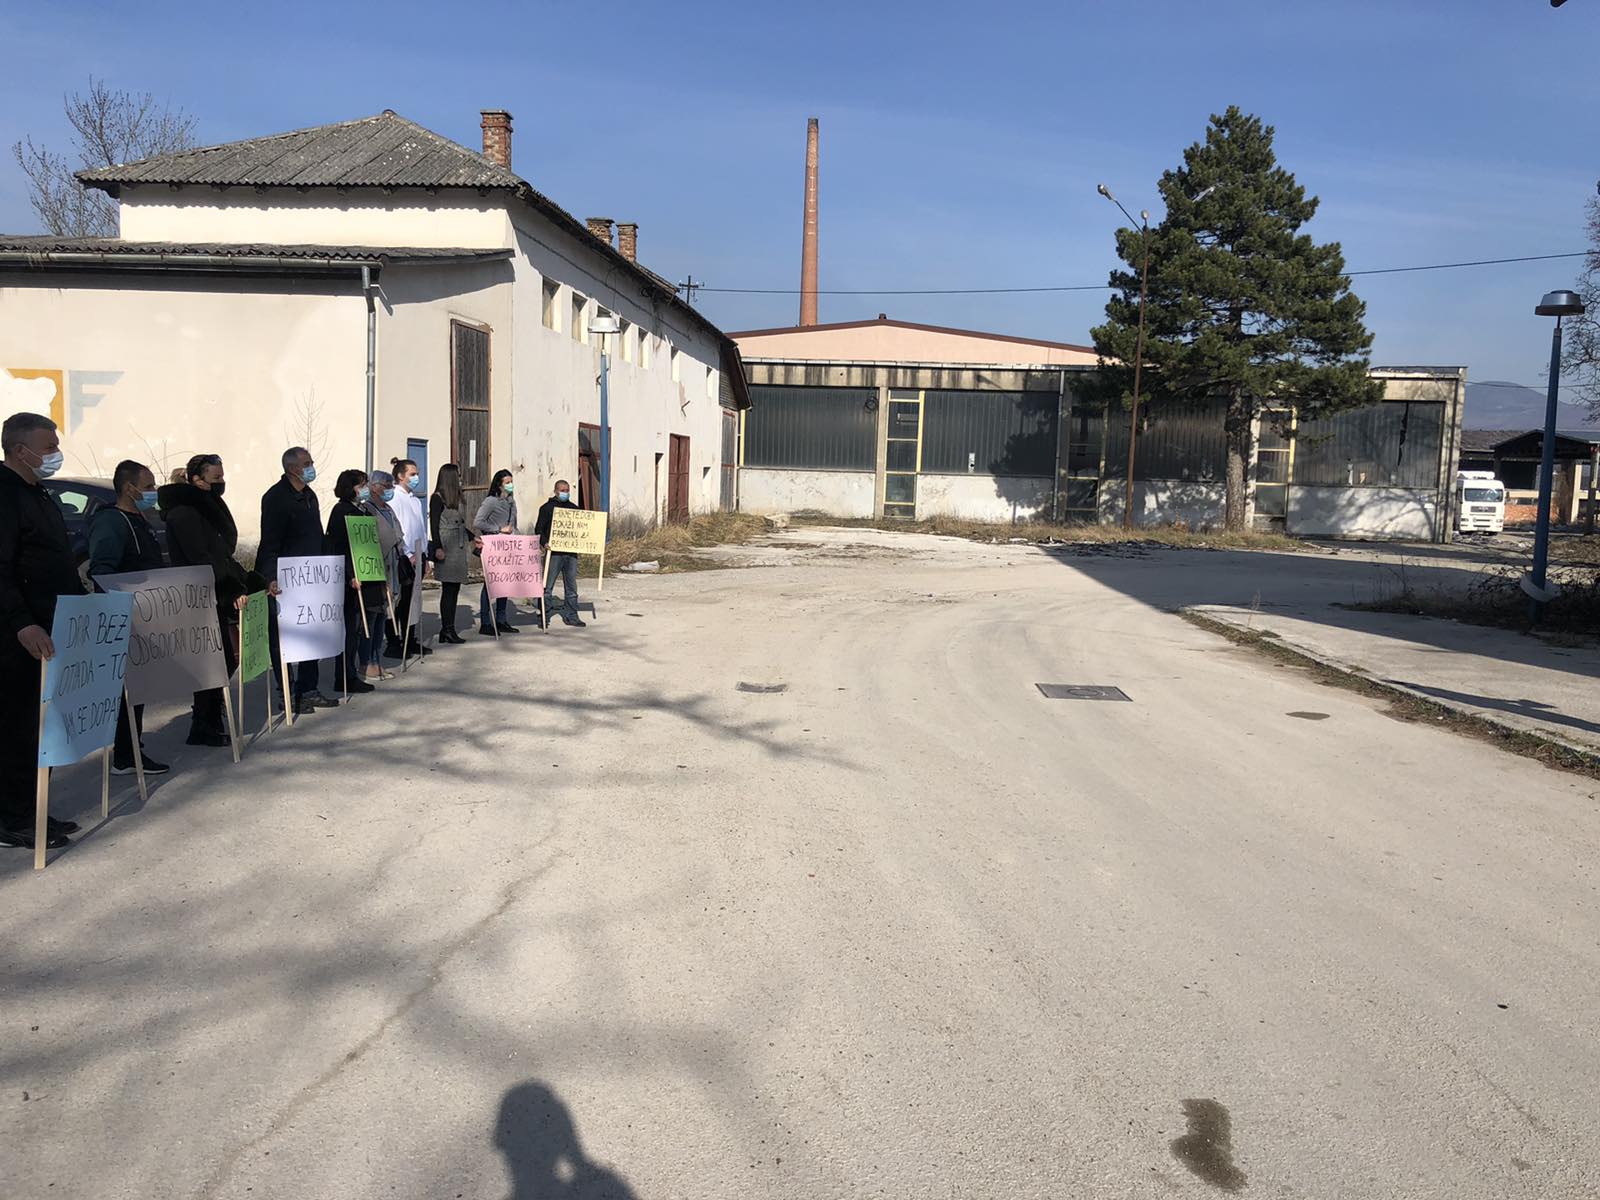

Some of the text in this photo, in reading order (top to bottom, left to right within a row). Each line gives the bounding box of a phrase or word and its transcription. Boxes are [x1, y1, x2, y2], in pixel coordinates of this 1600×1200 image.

[281, 560, 330, 588] TRAŽIMO
[134, 586, 182, 622] OTPAD
[296, 605, 316, 625] ZA
[96, 612, 129, 645] BEZ
[190, 626, 223, 655] OSTAJU
